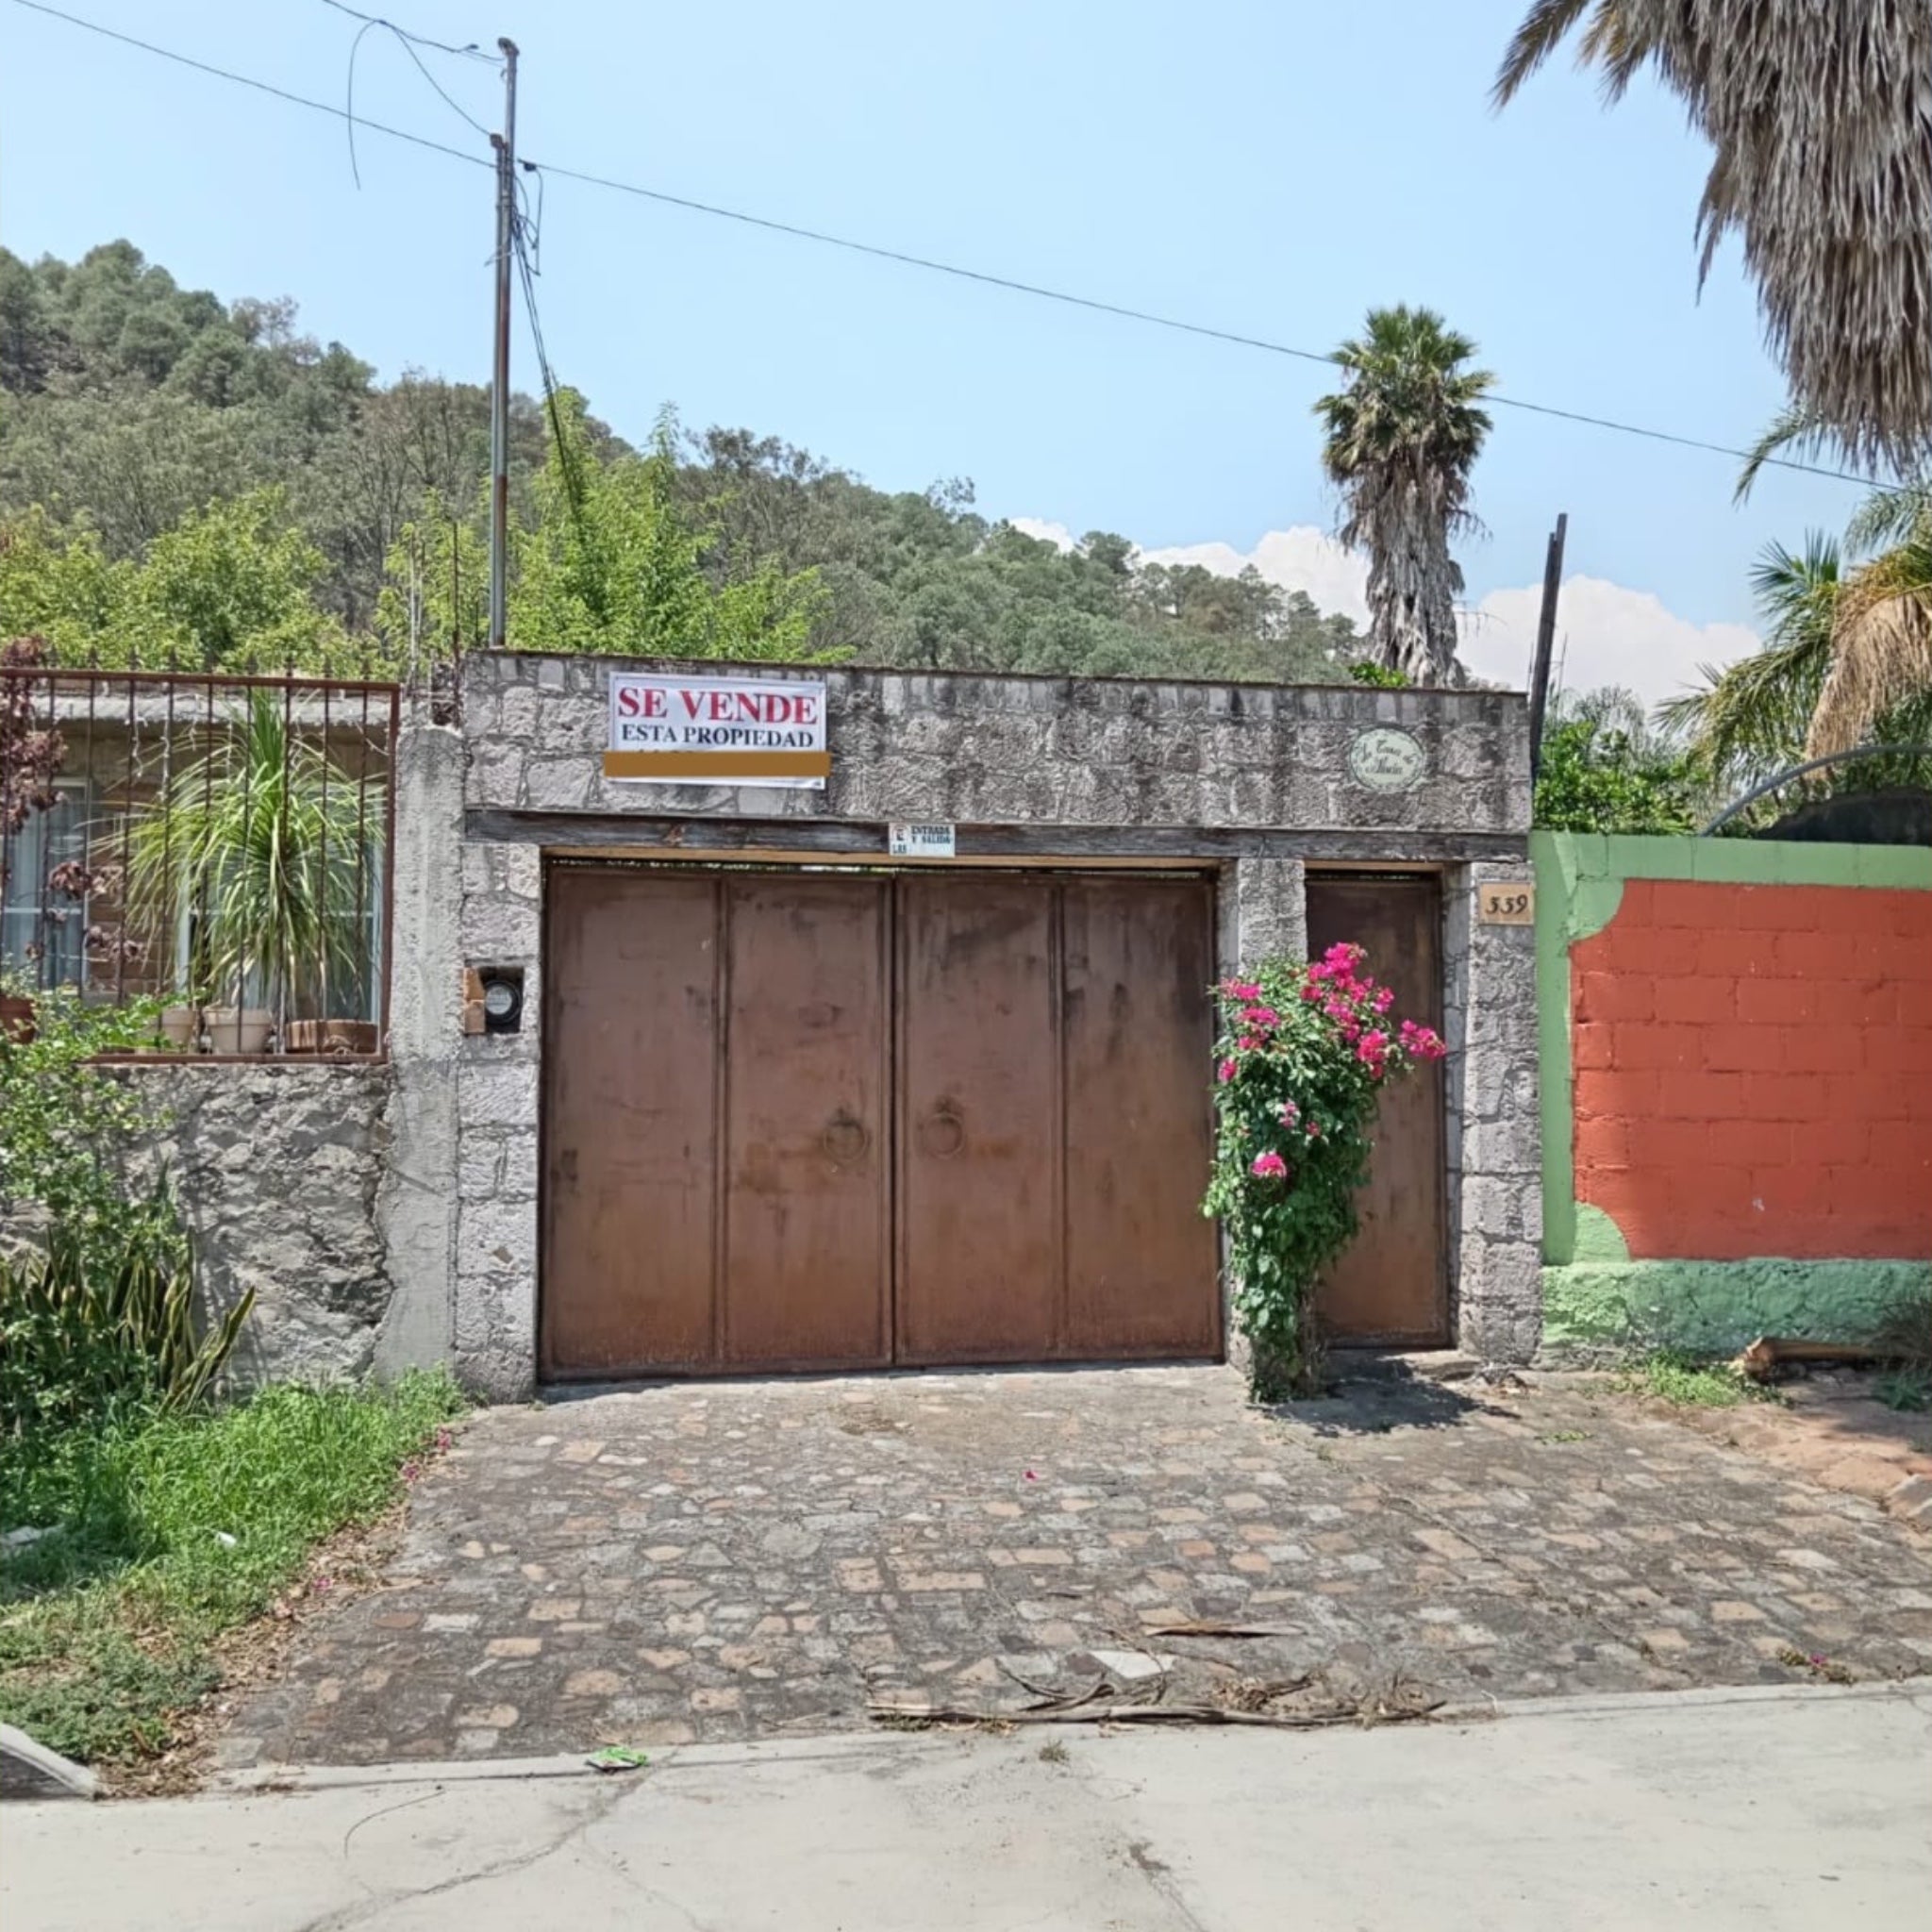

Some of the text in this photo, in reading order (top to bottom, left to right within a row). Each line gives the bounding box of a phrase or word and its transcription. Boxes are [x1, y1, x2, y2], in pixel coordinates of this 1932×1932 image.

[618, 687, 818, 724] SE VENDE
[622, 724, 814, 748] ESTA PROPIEDAD
[911, 825, 951, 835] ENTRADA
[922, 835, 951, 844] SALIDA
